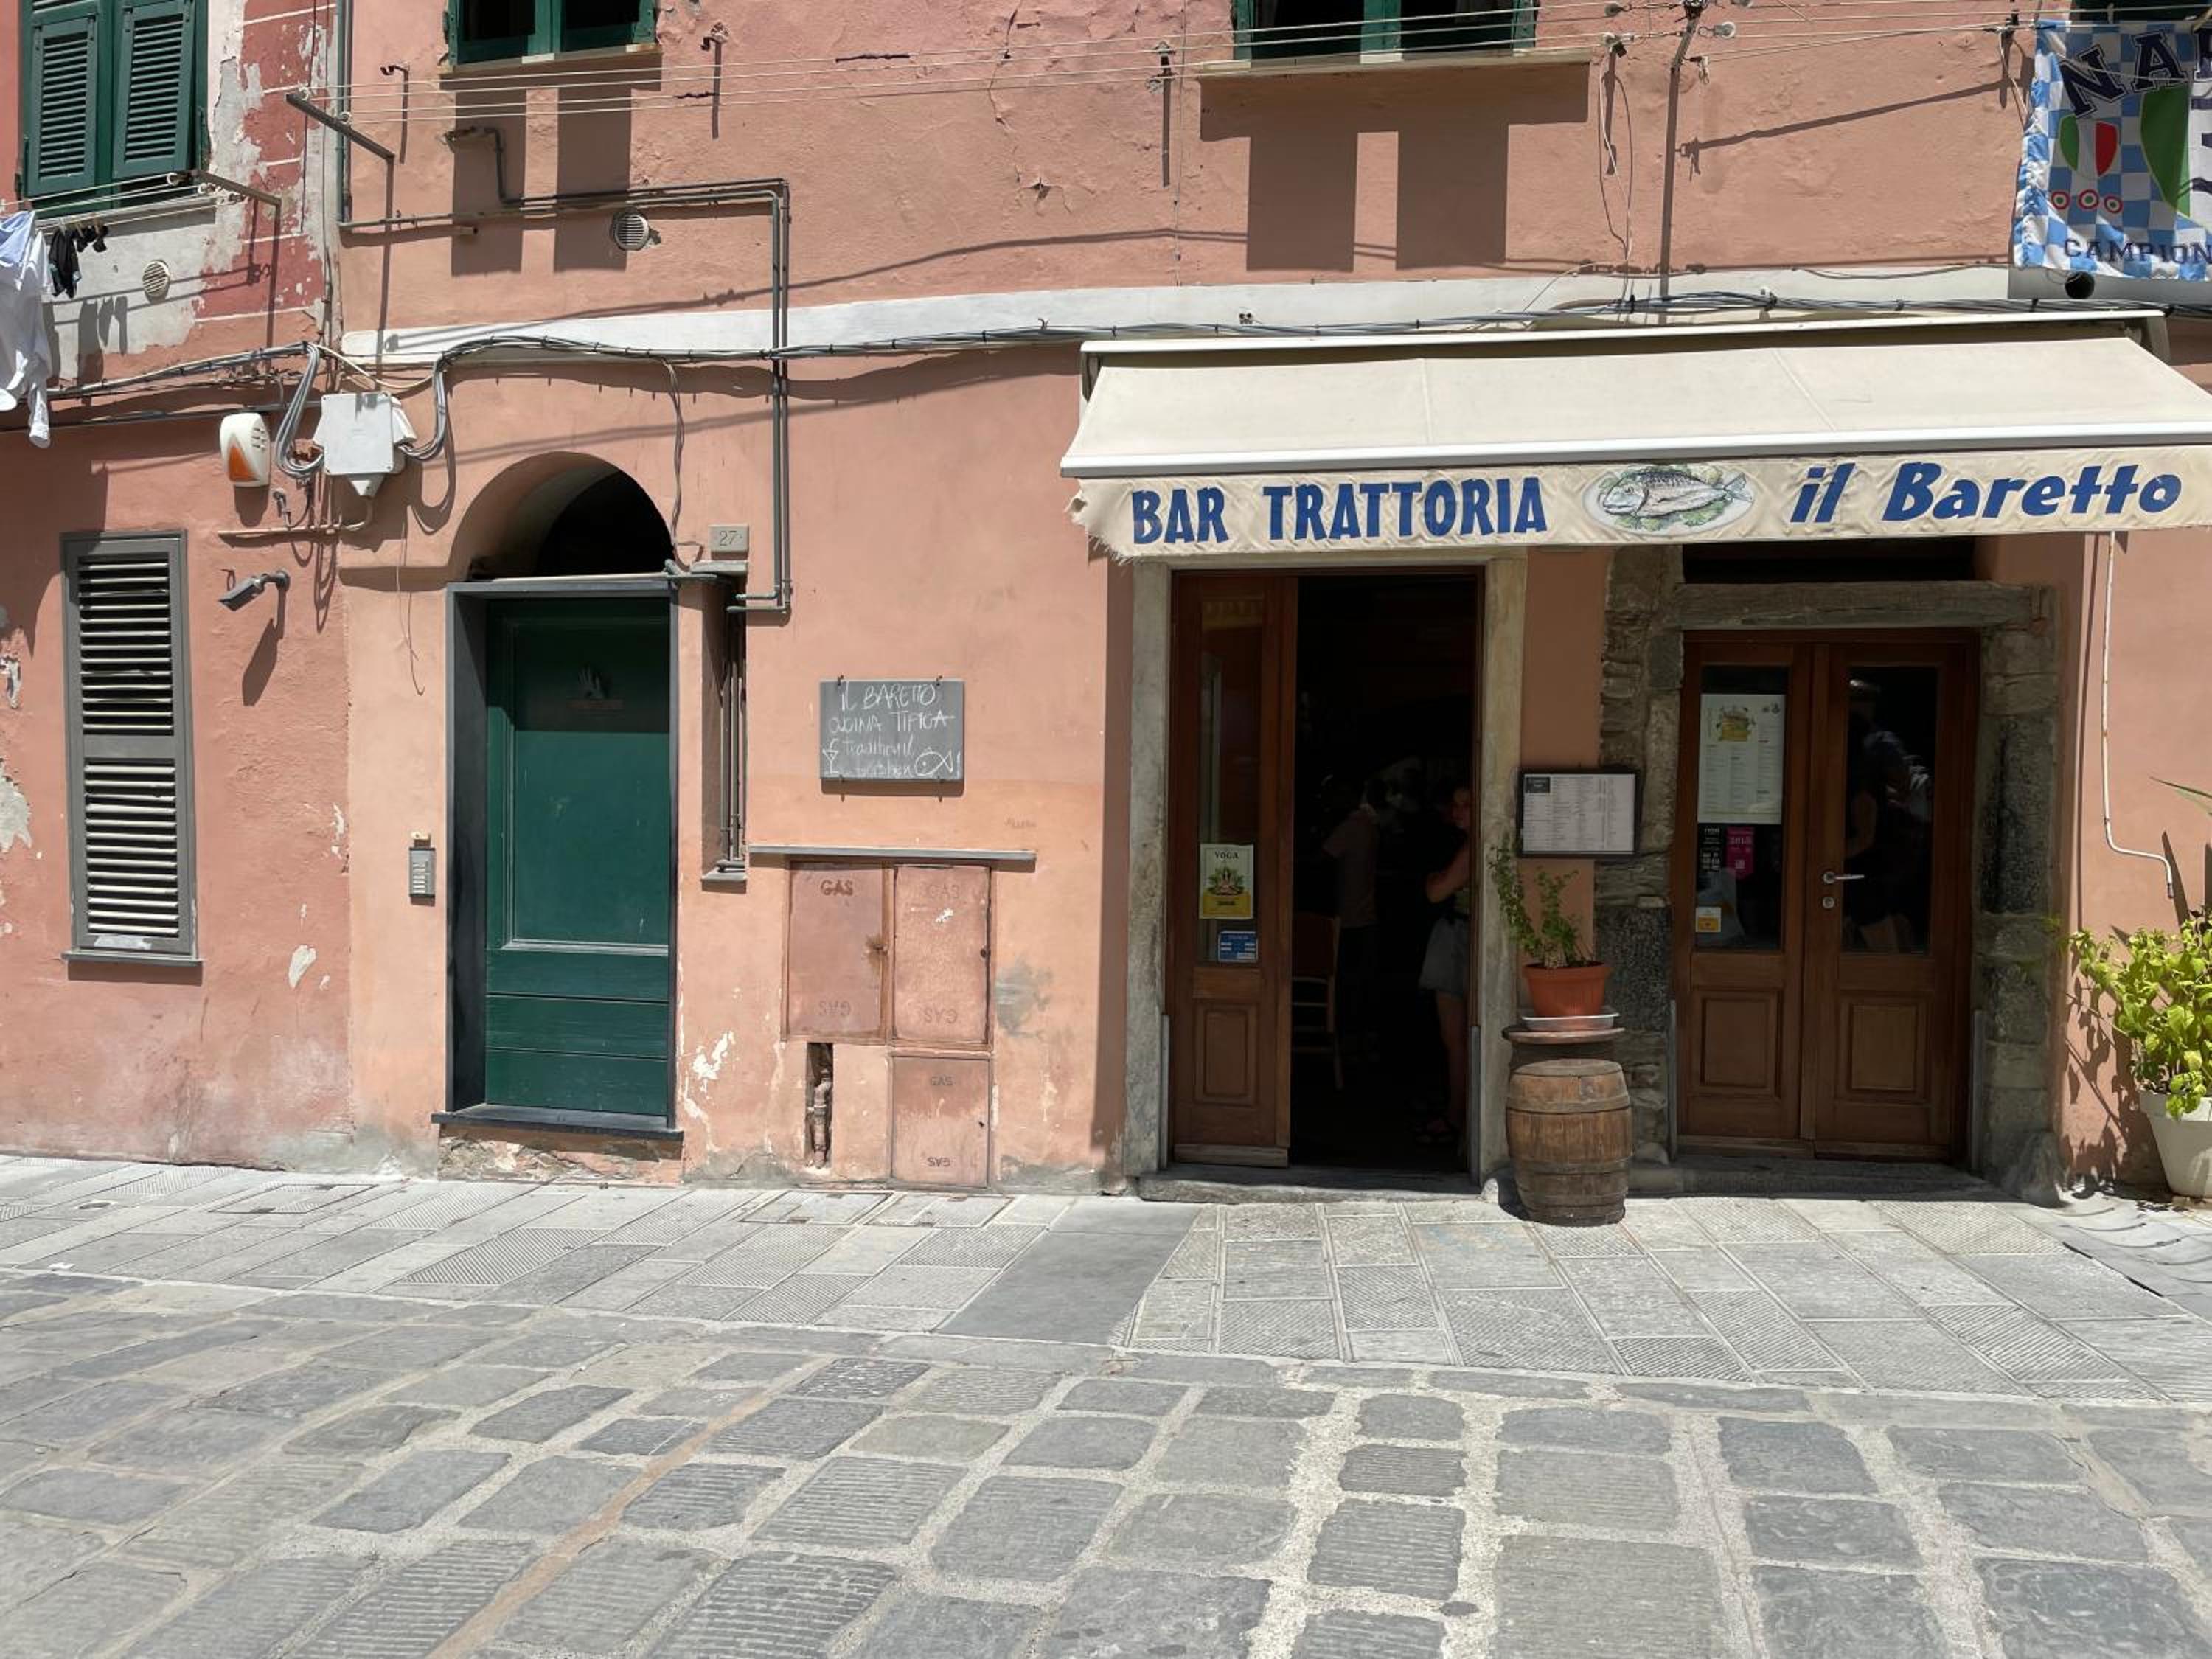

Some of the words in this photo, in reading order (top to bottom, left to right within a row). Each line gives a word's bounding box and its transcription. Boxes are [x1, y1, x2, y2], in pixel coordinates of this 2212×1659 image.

[1132, 487, 1229, 544] BAR
[1263, 477, 1547, 540] TRATTORIA
[1790, 462, 1856, 524] il
[1882, 462, 2182, 521] Baretto
[820, 880, 855, 897] GAS
[931, 1077, 953, 1087] GAS
